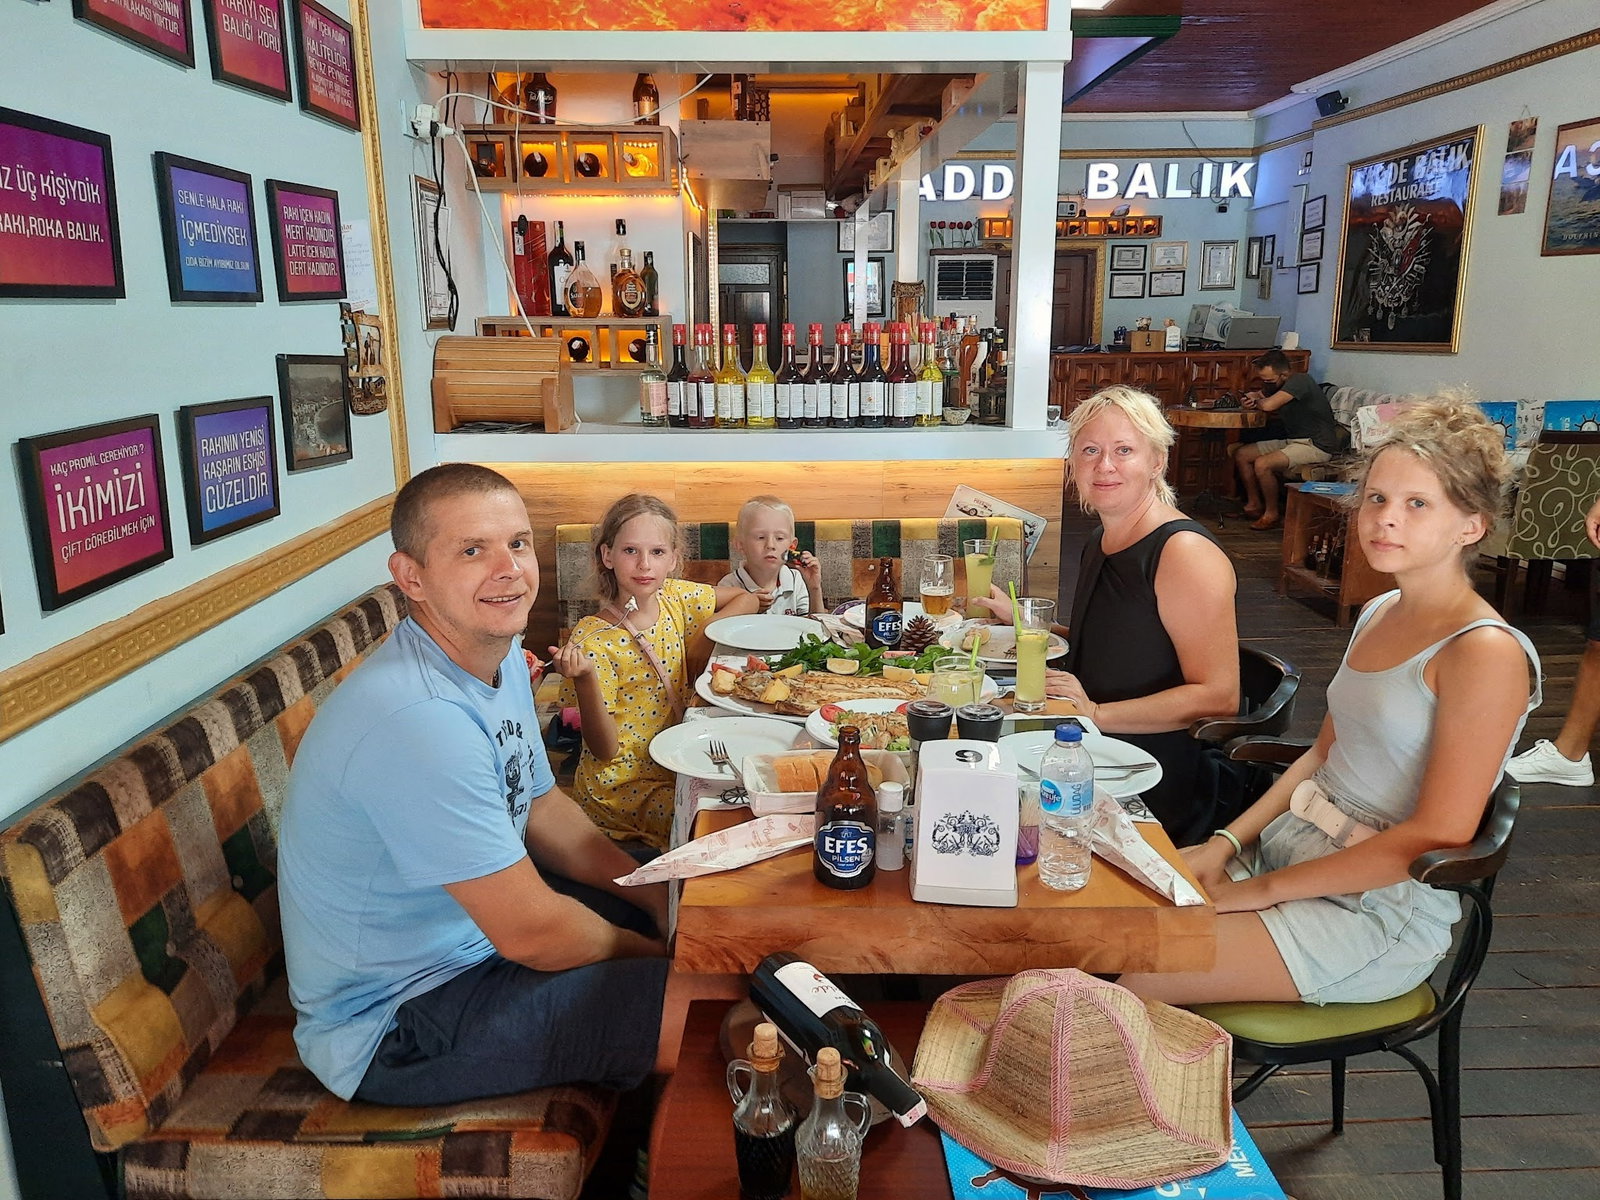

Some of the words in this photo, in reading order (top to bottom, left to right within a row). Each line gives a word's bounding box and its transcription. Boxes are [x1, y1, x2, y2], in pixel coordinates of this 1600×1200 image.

[259, 4, 277, 30] SEV
[222, 13, 254, 42] BALIĞI
[257, 28, 281, 53] KORU
[16, 163, 37, 202] ÜÇ
[40, 169, 101, 206] KİŞİYDİK
[1086, 161, 1257, 200] BALIK
[177, 189, 206, 208] SENLE
[205, 195, 227, 212] HALA
[227, 199, 245, 215] RAKI
[283, 205, 300, 221] RAKI
[299, 204, 314, 226] İÇEN
[66, 221, 104, 243] BALIK.
[180, 214, 248, 247] İÇMEDİYSEK
[284, 223, 305, 240] MERT
[286, 243, 306, 258] LATTE
[289, 260, 307, 276] DERT
[201, 432, 239, 458] RAKININ
[239, 423, 265, 450] YENİSİ
[50, 462, 69, 478] KAÇ
[68, 451, 100, 473] PROMİL
[202, 455, 242, 483] KAŞARIN
[241, 446, 267, 472] ESKİSİ
[54, 461, 146, 533] İKİMİZİ
[60, 540, 84, 564] ÇİFT
[139, 512, 156, 534] İÇİN
[878, 620, 902, 632] EFES
[824, 836, 868, 854] EFES
